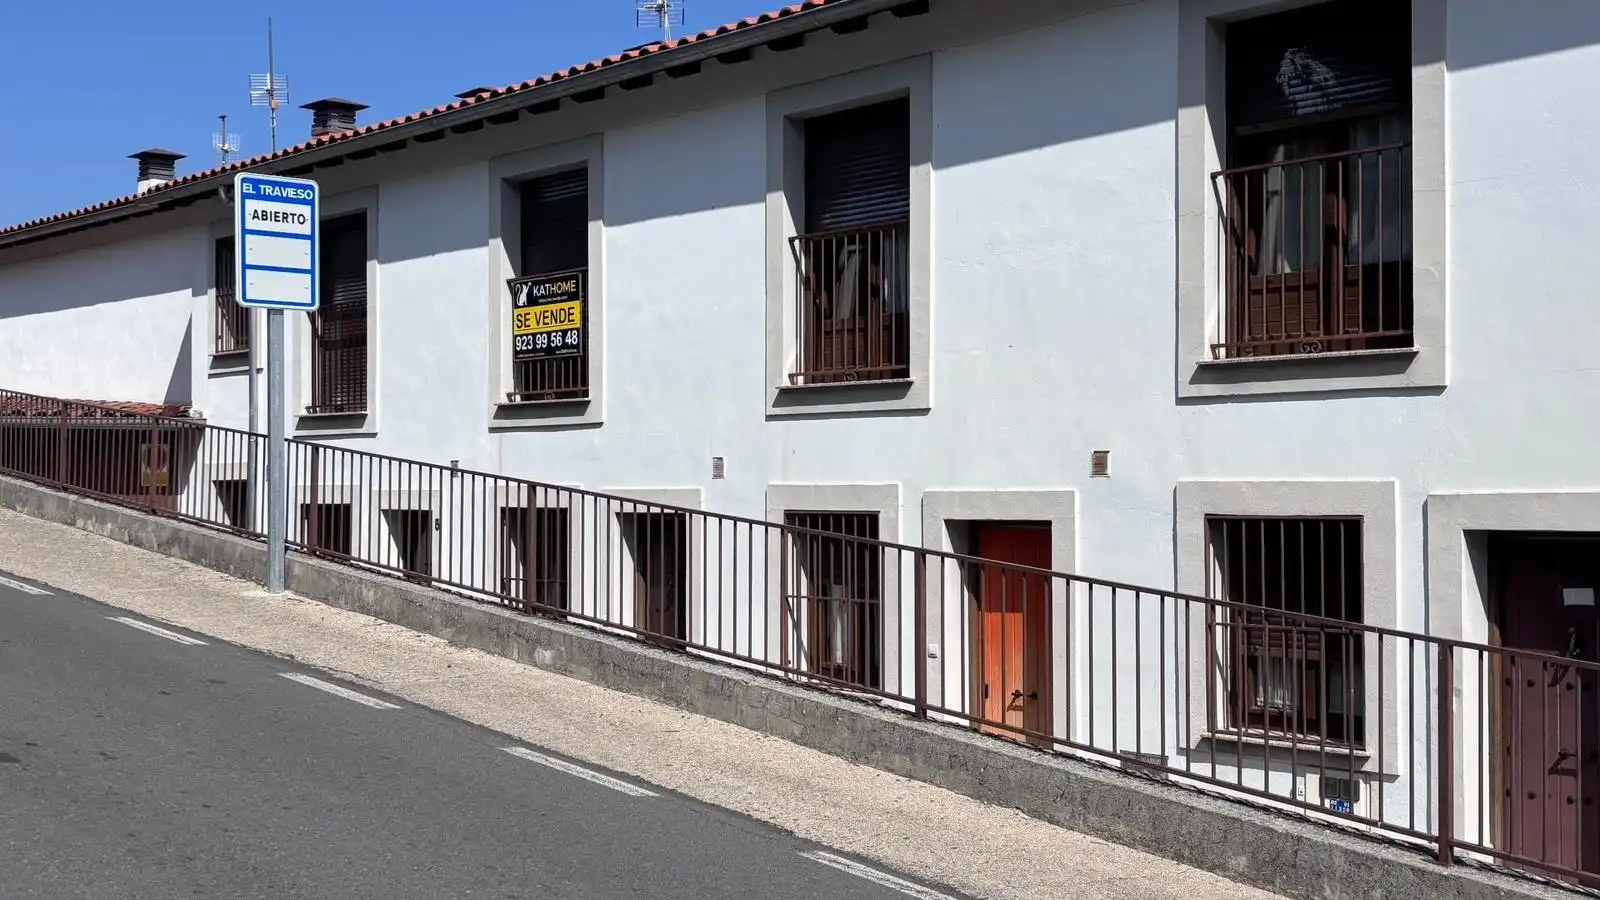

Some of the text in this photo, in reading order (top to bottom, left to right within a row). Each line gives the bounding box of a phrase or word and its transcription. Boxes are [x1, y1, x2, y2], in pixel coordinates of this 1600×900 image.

[242, 182, 314, 200] EL TRAVIESO
[251, 208, 306, 225] ABIERTO
[533, 280, 577, 297] KATHOME
[516, 306, 576, 329] SE VENDE
[515, 329, 578, 351] 923 99 56 48
